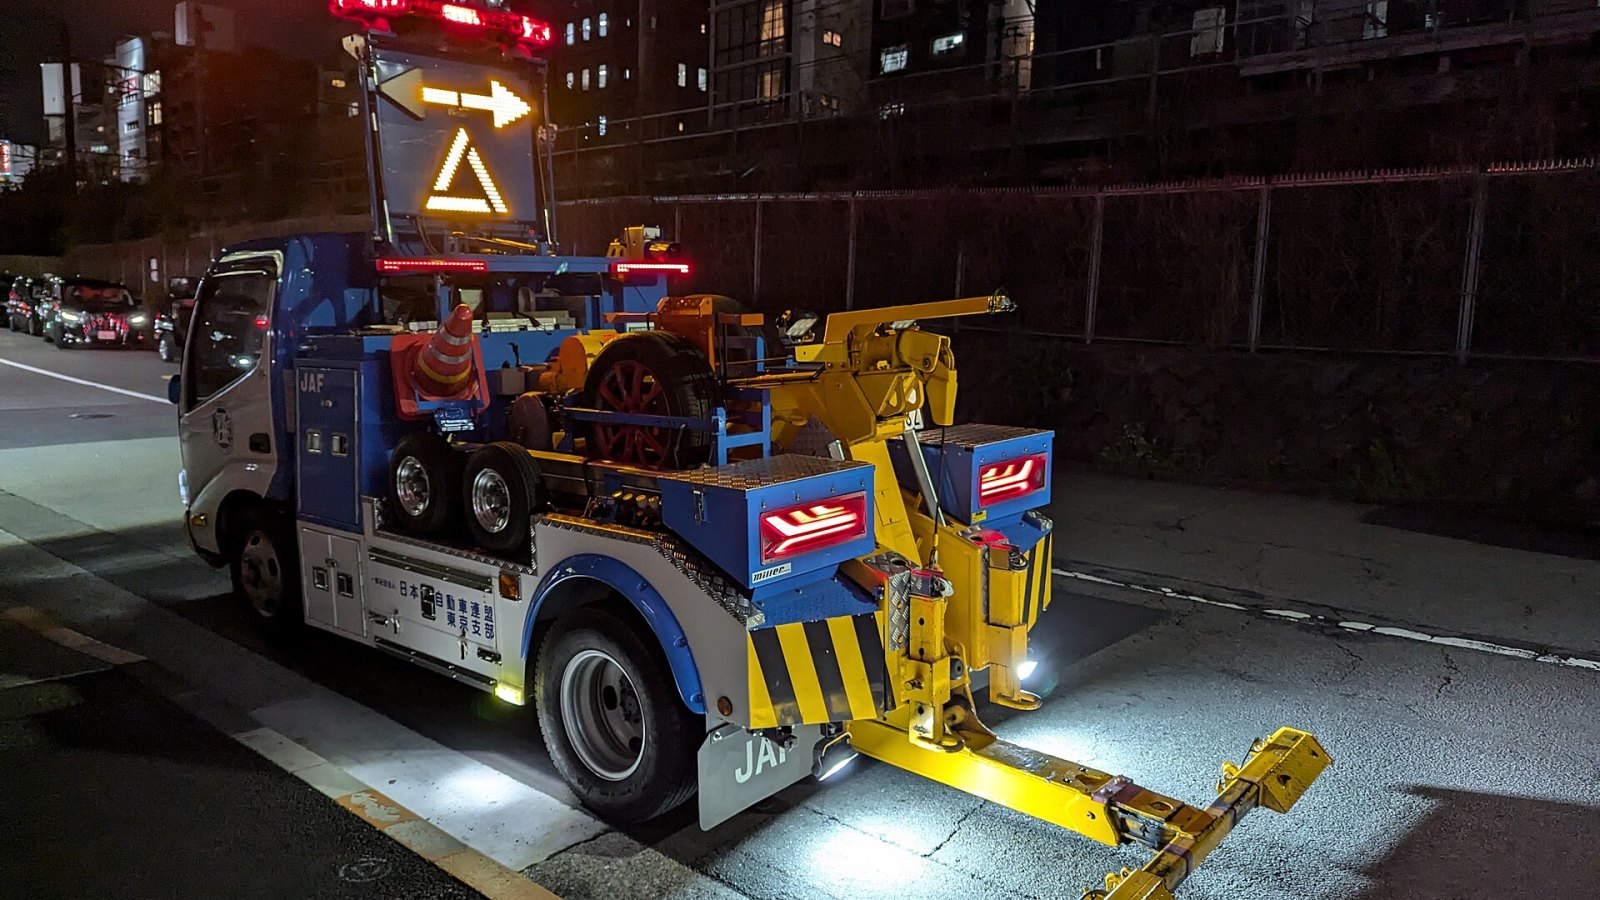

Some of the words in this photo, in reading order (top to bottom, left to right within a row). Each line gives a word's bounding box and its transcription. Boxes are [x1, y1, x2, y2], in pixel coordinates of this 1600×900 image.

[300, 372, 324, 392] JAF
[753, 566, 785, 582] miller
[400, 580, 494, 623] 日本自動車連盟
[447, 611, 495, 641] 東京支部
